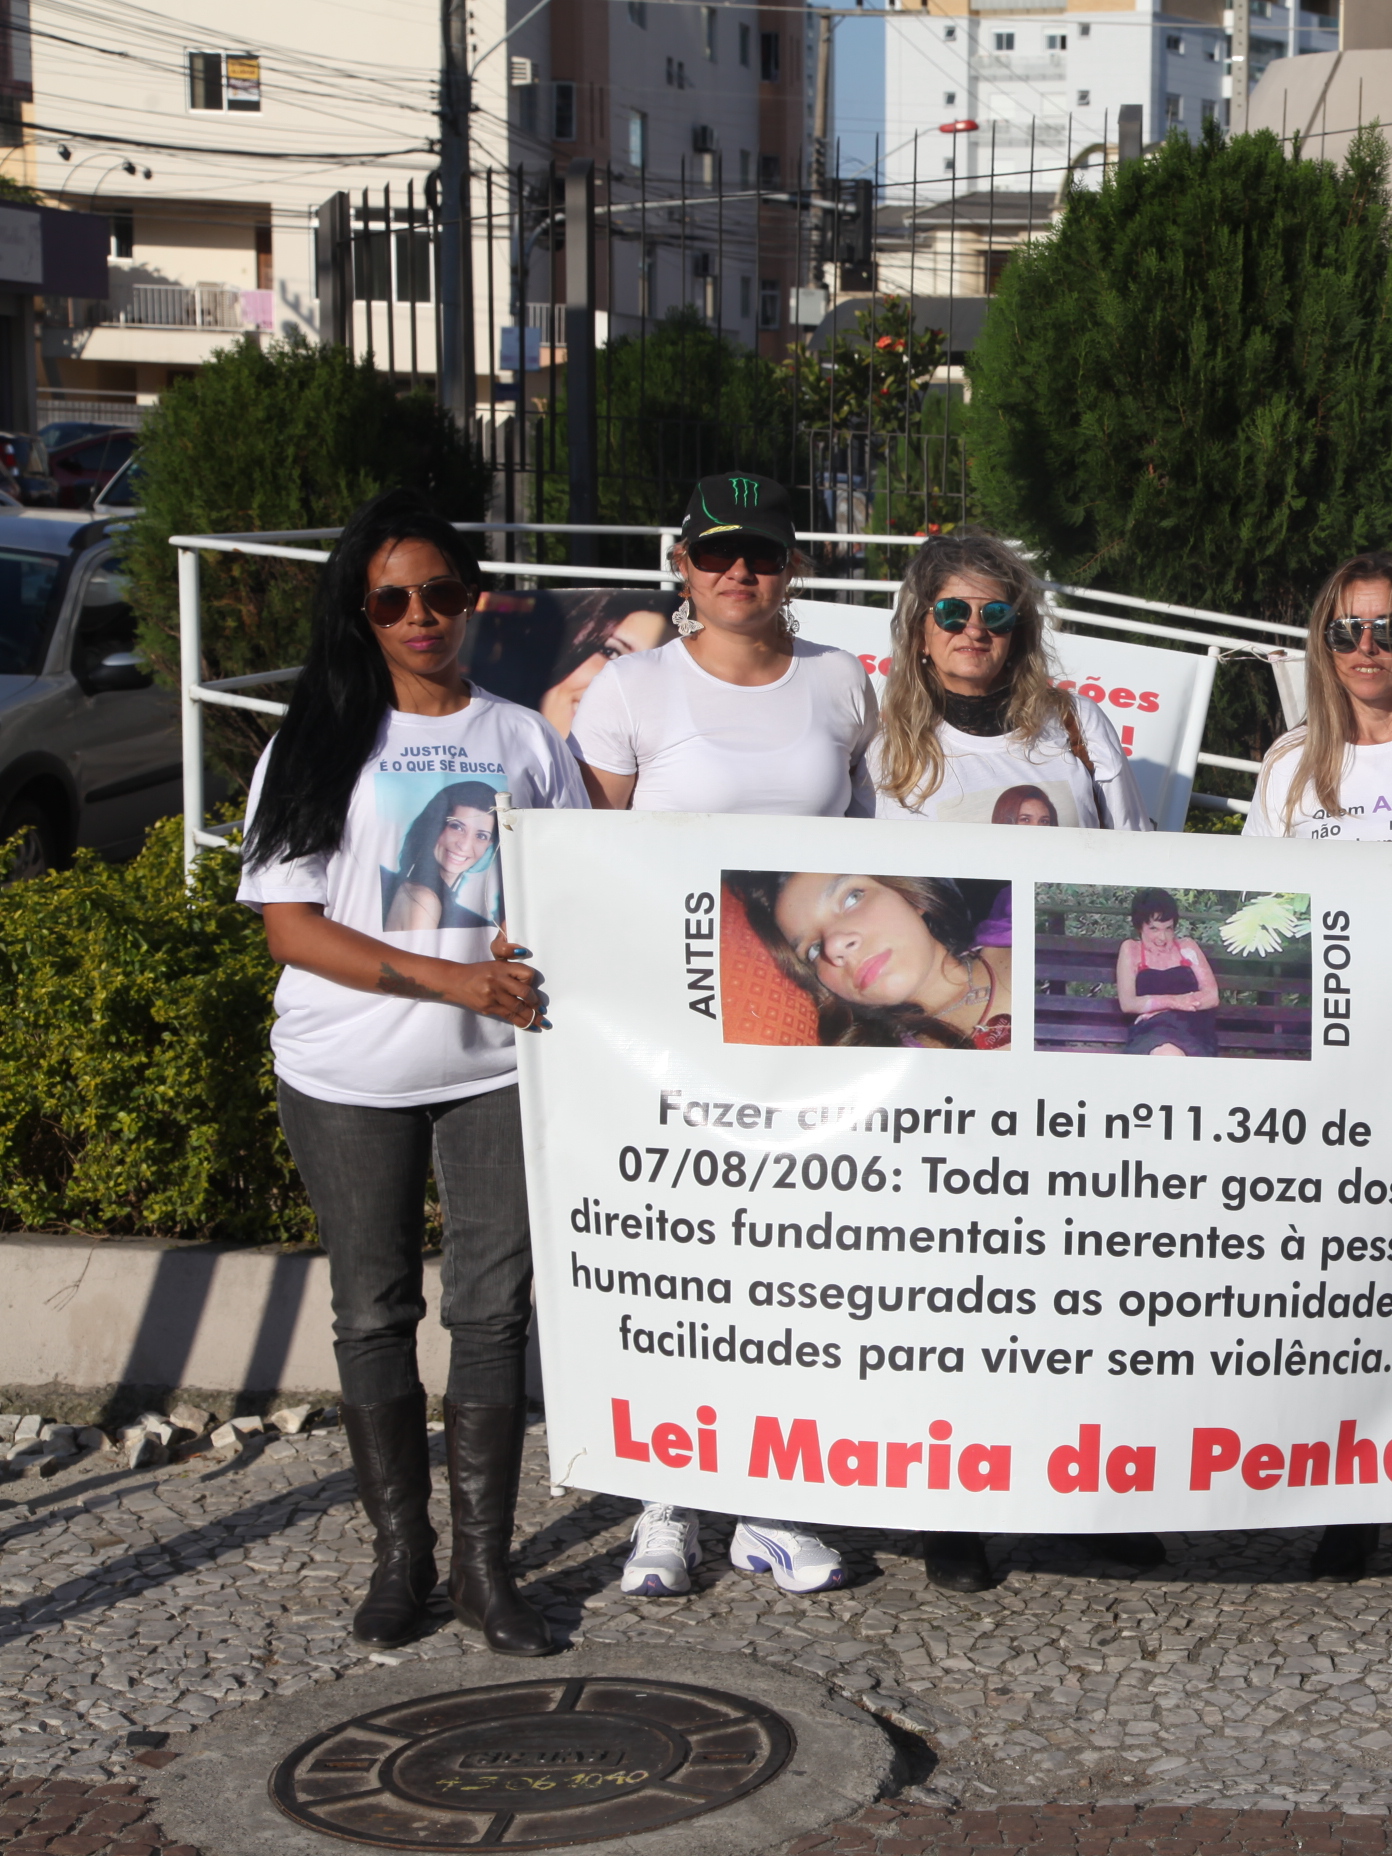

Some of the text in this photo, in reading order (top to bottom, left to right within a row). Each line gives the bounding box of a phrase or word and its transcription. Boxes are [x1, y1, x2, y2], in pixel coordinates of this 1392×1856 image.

[379, 758, 505, 775] É O QUE SE BUSCA
[400, 745, 469, 760] JUSTIÇA
[1311, 823, 1341, 839] não
[685, 892, 716, 1019] ANTES
[1323, 911, 1350, 1046] DEPOIS
[658, 1090, 783, 1130] Fazer
[991, 1111, 1016, 1136] a
[1037, 1099, 1086, 1137] lei
[1106, 1103, 1306, 1146] nº11.340
[1322, 1109, 1371, 1147] de
[619, 1146, 901, 1193] 07/08/2006:
[922, 1157, 1028, 1195] Toda
[1049, 1160, 1207, 1199] mulher
[1222, 1176, 1321, 1211] goza
[571, 1197, 715, 1245] direitos
[732, 1208, 1045, 1255] fundamentais
[1065, 1218, 1264, 1260] inerentes
[1281, 1224, 1304, 1261] à
[572, 1251, 731, 1303] humana
[749, 1275, 1036, 1321] asseguradas
[1054, 1290, 1102, 1316] as
[620, 1315, 1392, 1380] facilidades para viver sem violência.
[612, 1399, 718, 1473] Lei
[748, 1416, 1011, 1492] Maria
[1047, 1424, 1156, 1493] da
